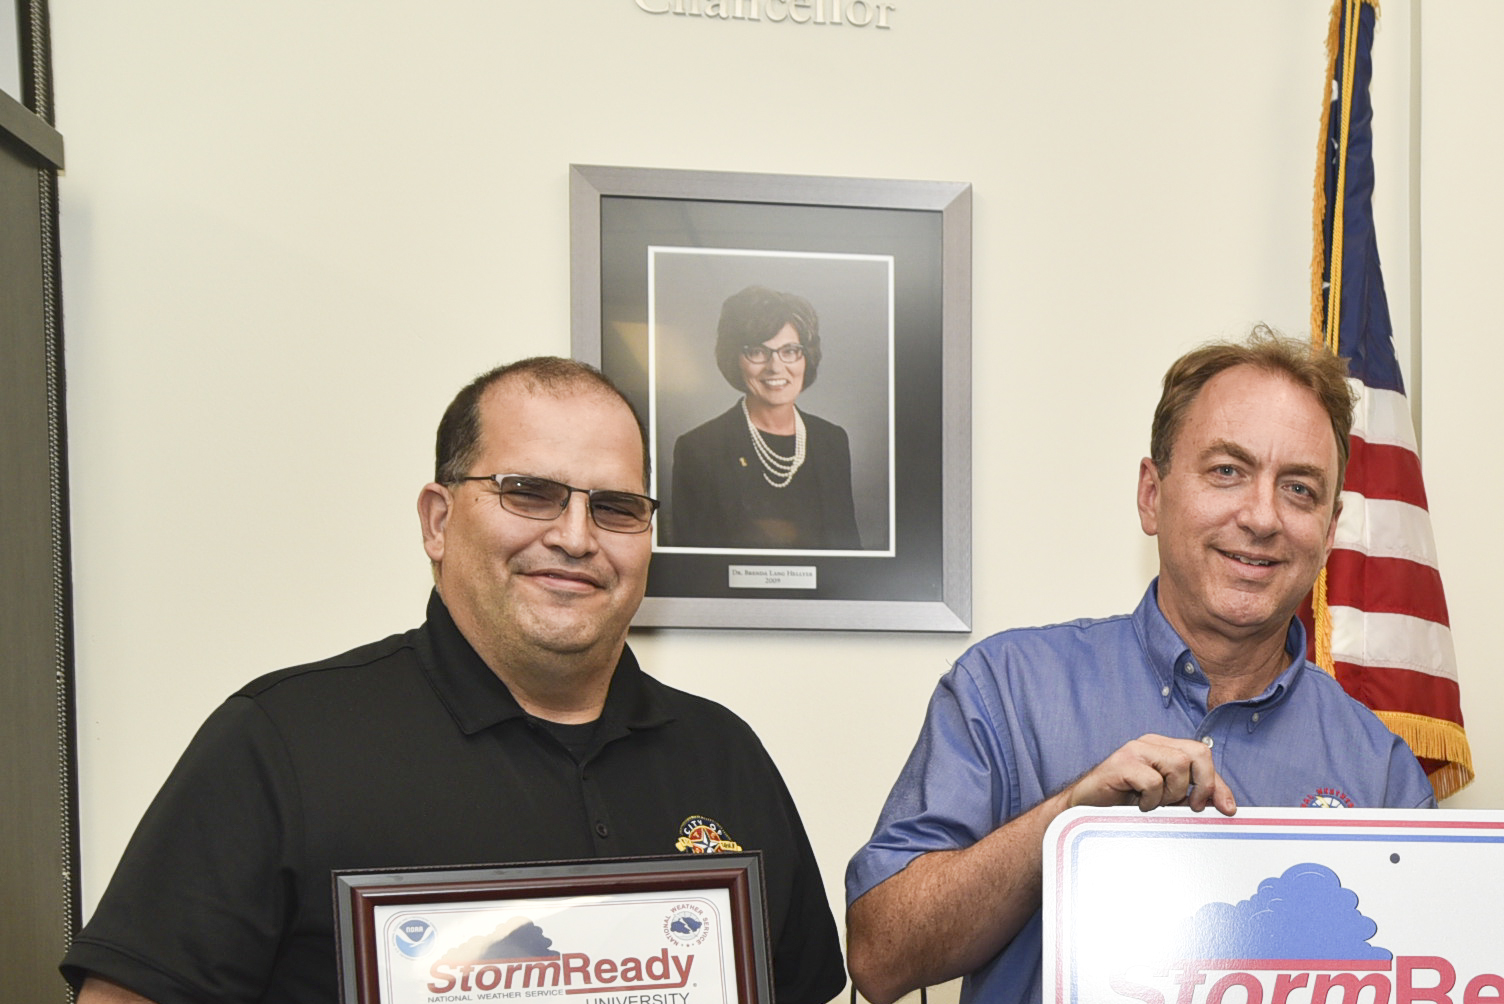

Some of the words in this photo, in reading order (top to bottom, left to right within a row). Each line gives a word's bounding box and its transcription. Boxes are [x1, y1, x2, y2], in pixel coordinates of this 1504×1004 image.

[684, 820, 703, 834] CITY
[427, 948, 694, 995] StormReady
[428, 994, 472, 1004] NATIONAL
[477, 992, 522, 1000] WEATHER
[525, 988, 564, 998] SERVICE
